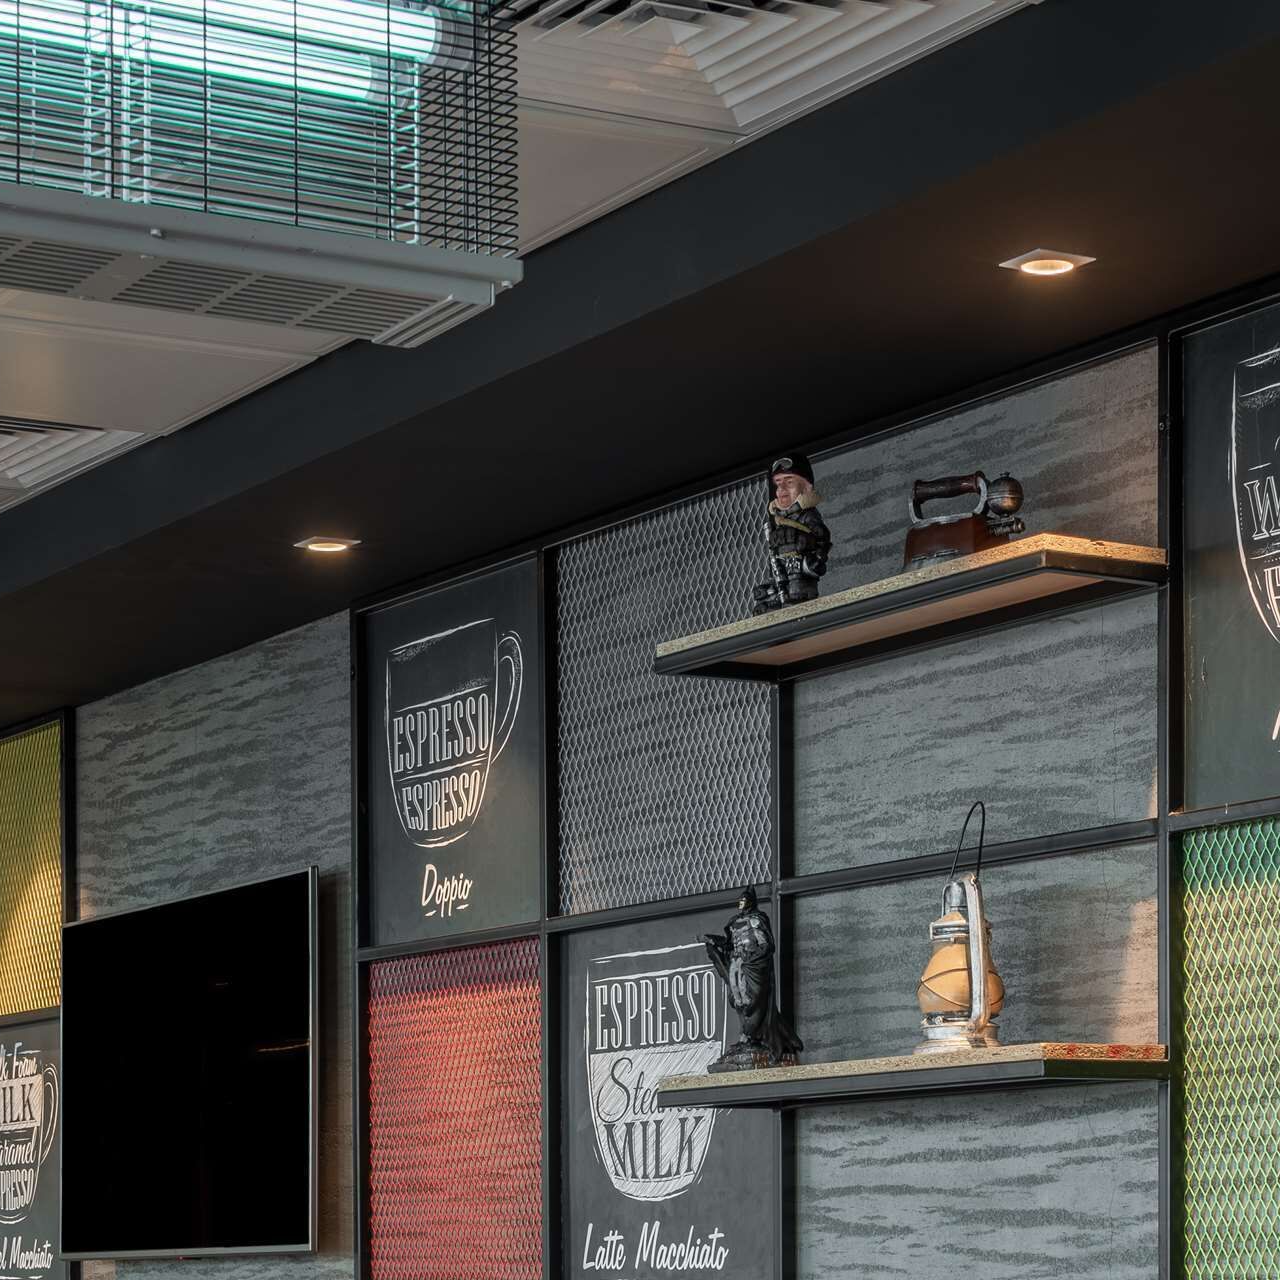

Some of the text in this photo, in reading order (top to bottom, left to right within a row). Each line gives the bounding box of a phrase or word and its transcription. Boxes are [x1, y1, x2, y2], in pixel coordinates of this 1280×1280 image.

[393, 693, 489, 773] ESPRESSO
[402, 770, 480, 831] ESPRESSO
[422, 864, 472, 917] Doppio
[595, 971, 716, 1050] ESPRESSO
[12, 1042, 37, 1079] Foam
[603, 1116, 705, 1180] MILK
[9, 1236, 53, 1270] Macchiato
[582, 1220, 728, 1270] Latte Macchiato
